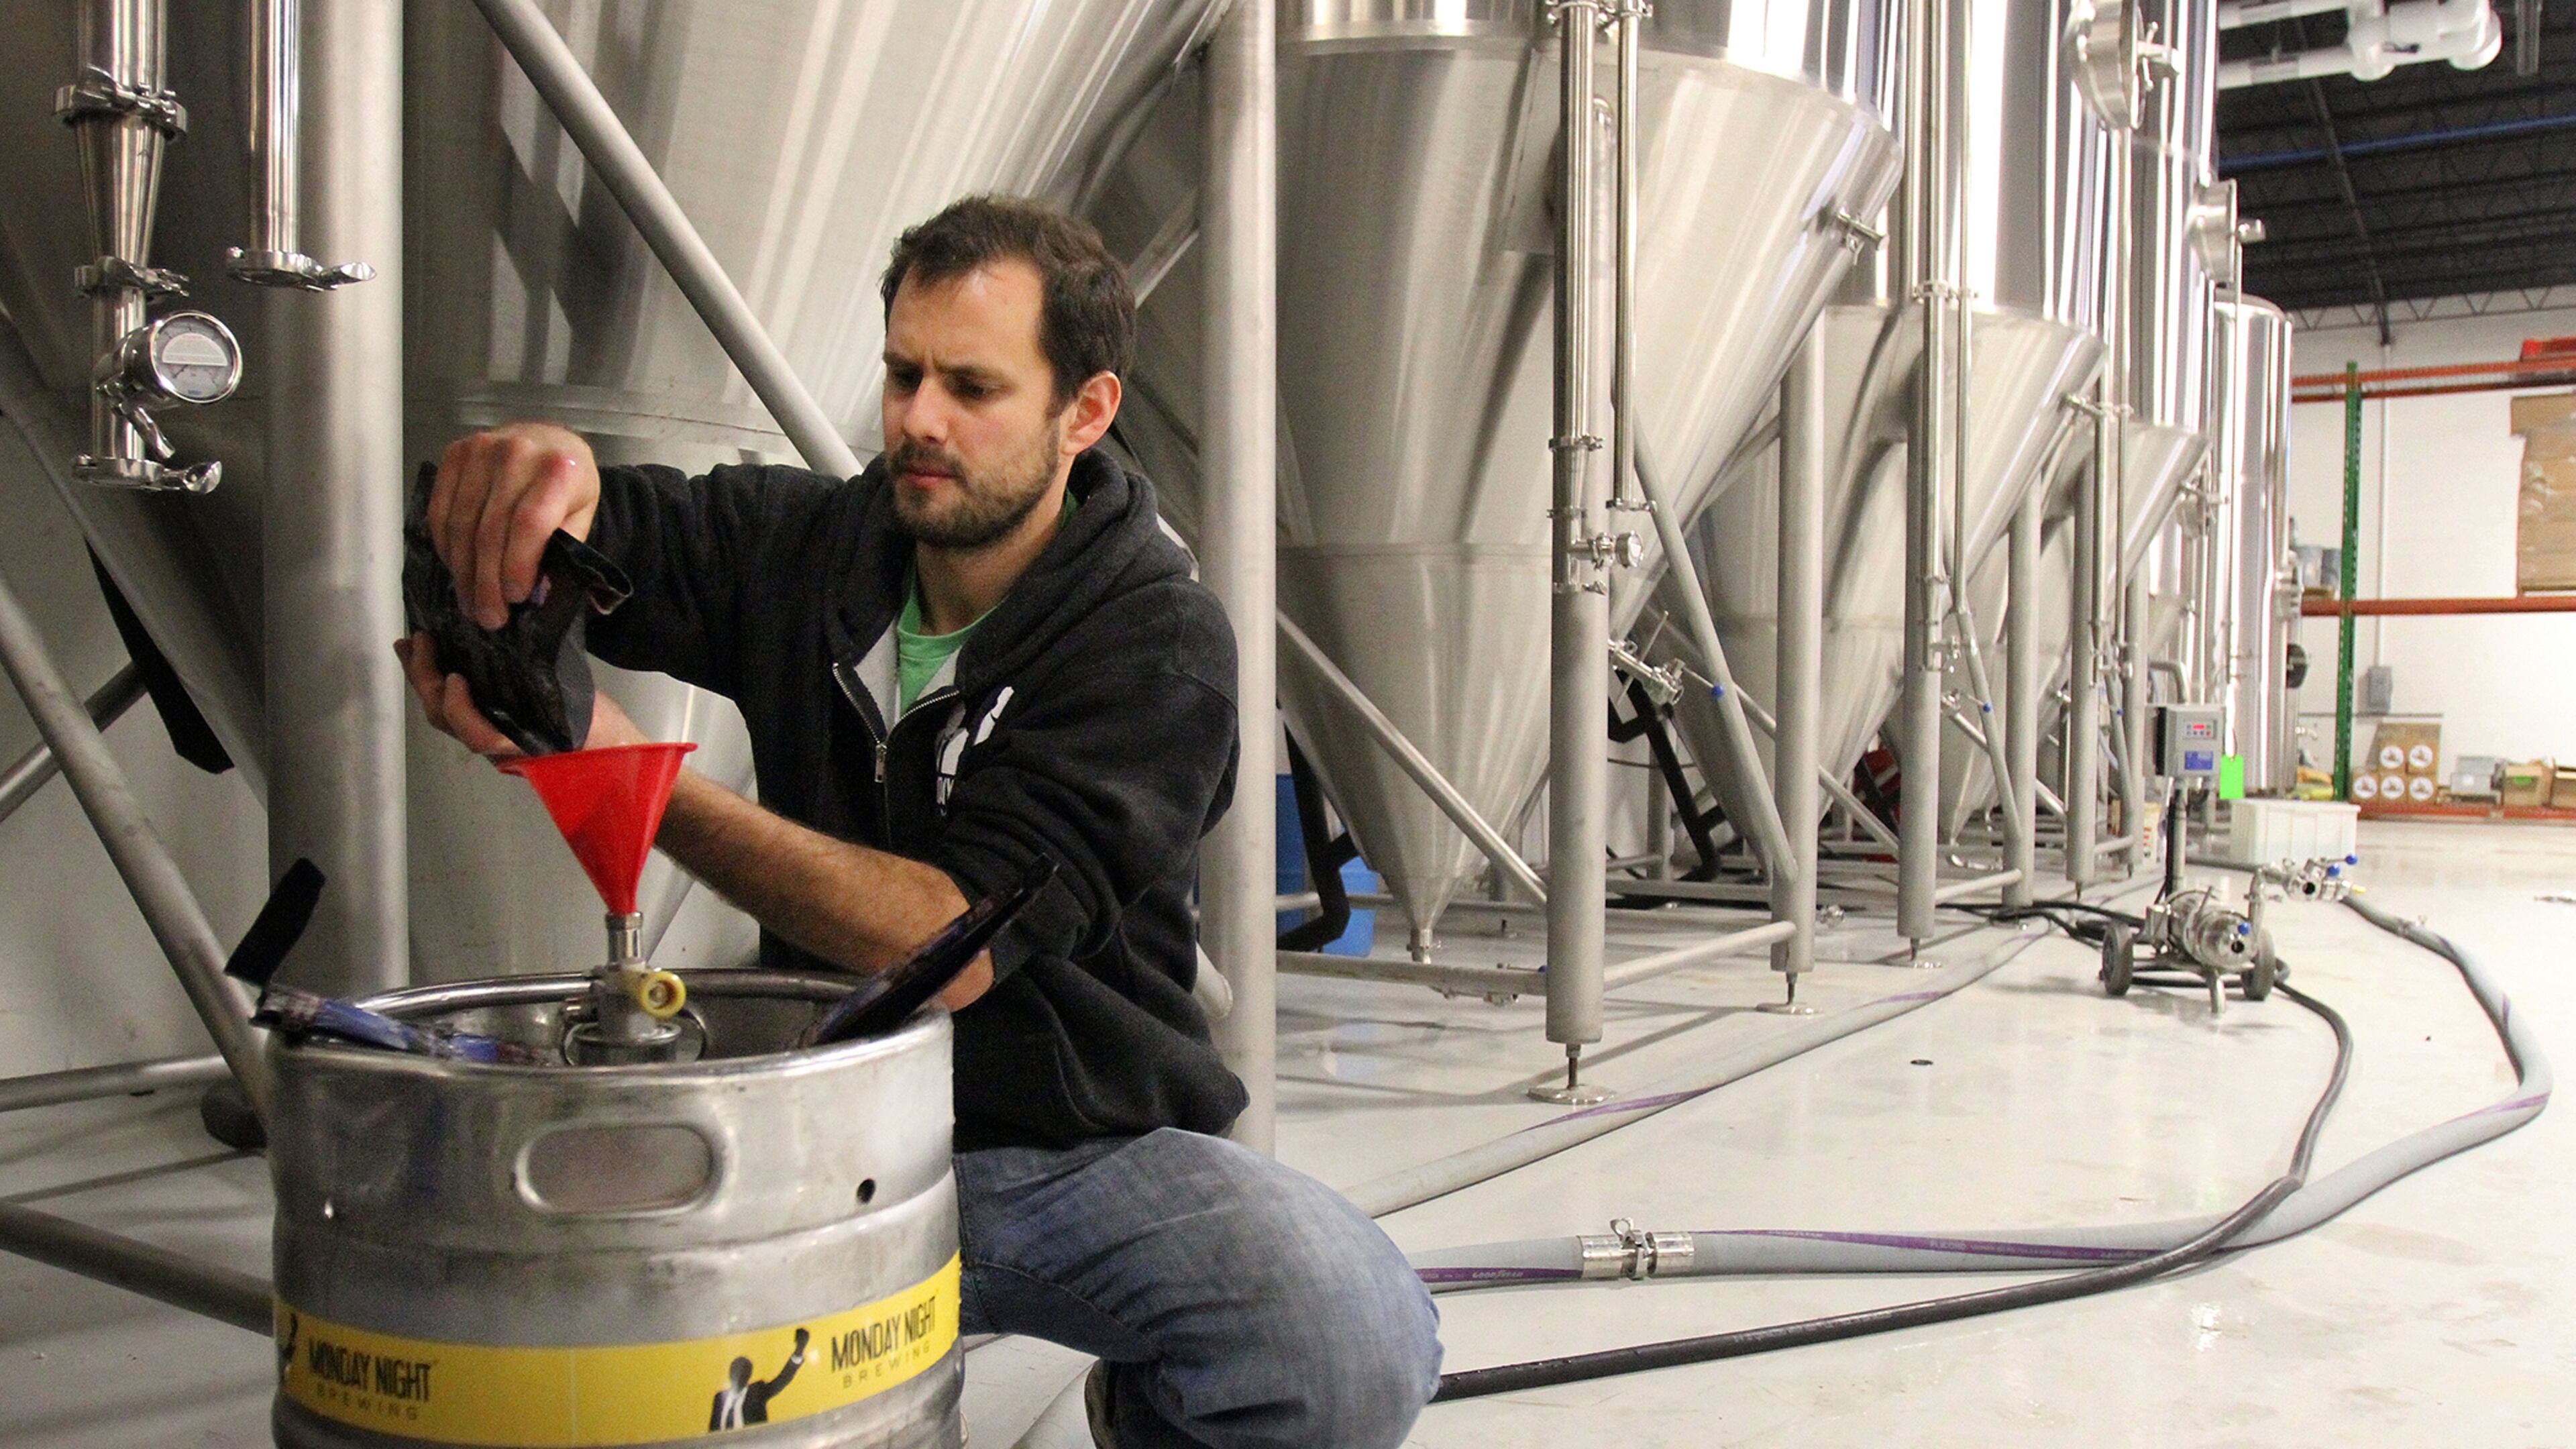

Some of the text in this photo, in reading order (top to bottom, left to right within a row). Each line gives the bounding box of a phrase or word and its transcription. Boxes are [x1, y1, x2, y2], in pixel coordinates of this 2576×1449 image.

[831, 1295, 936, 1373] MONDAY NIGHT
[309, 1337, 431, 1402] MONDAY NIGHT
[842, 1340, 930, 1389] BREWING
[317, 1382, 418, 1421] BREWING
